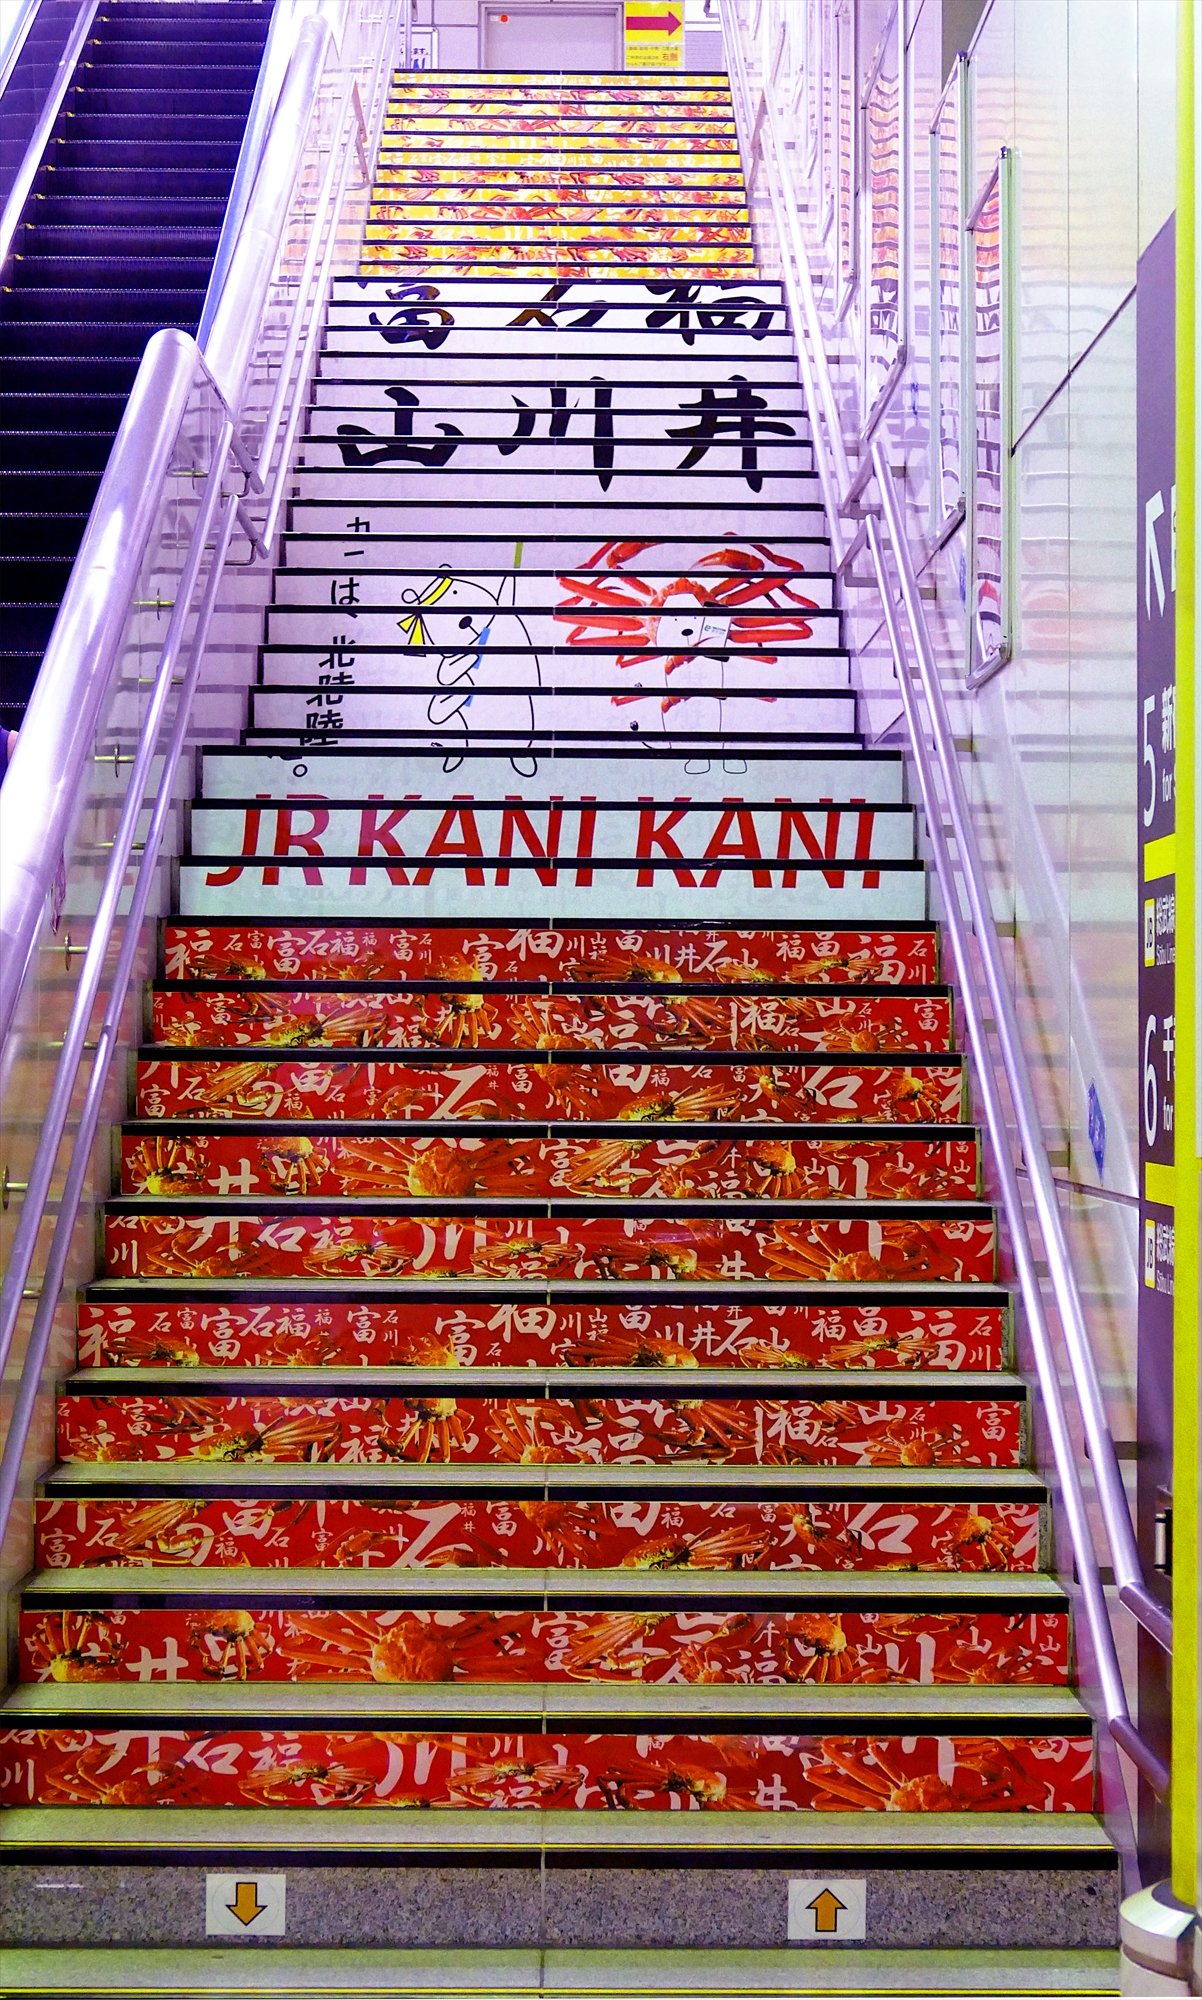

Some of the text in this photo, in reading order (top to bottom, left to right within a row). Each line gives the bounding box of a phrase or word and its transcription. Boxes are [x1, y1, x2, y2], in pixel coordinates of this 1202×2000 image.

[1162, 684, 1175, 753] 新
[1144, 695, 1155, 827] 5
[1163, 768, 1172, 802] for
[205, 794, 880, 888] JR KANI KANI
[1144, 1014, 1157, 1147] 6
[1163, 1015, 1175, 1081] 千
[1164, 1096, 1173, 1131] for
